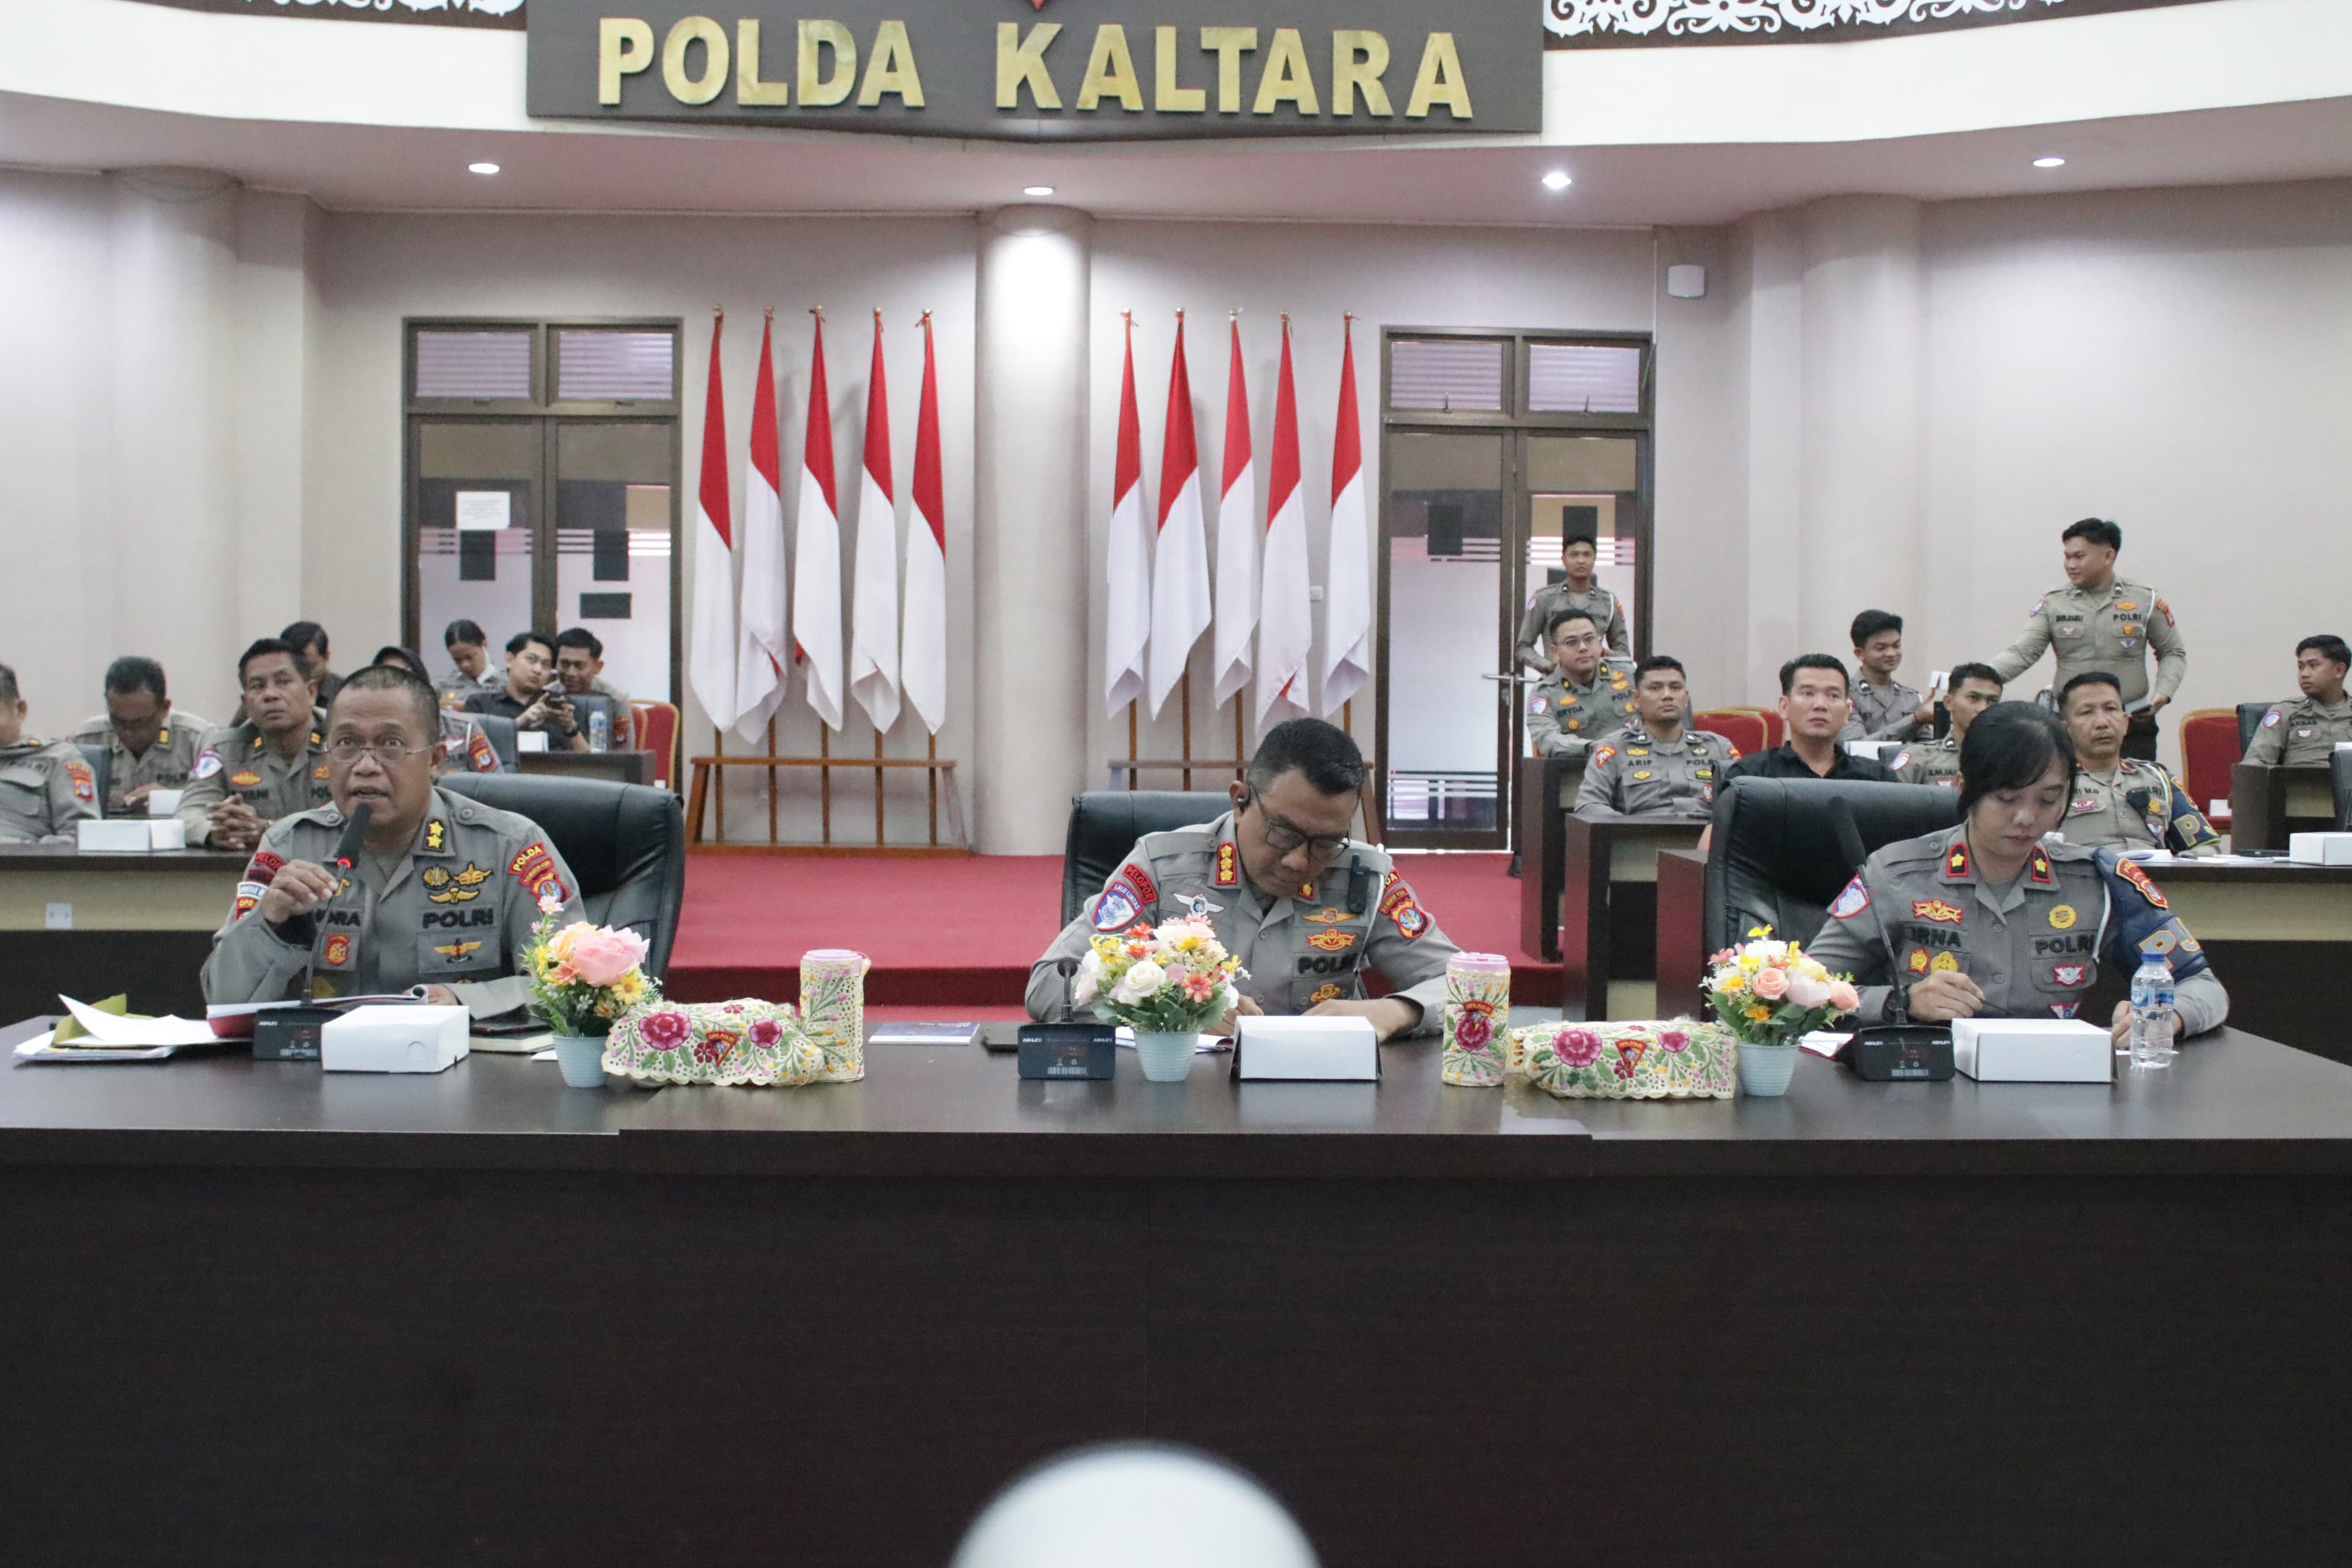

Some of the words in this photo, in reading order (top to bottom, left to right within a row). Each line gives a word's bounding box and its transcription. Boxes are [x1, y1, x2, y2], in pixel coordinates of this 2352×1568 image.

[599, 16, 926, 107] POLDA
[996, 22, 1473, 118] KALTARA
[512, 845, 542, 871] POLDA
[1126, 865, 1154, 901] PELOPOR
[1114, 883, 1127, 894] LALU
[1125, 891, 1141, 911] LINTAS
[423, 907, 494, 929] POLRI
[2035, 935, 2095, 955] POLRI
